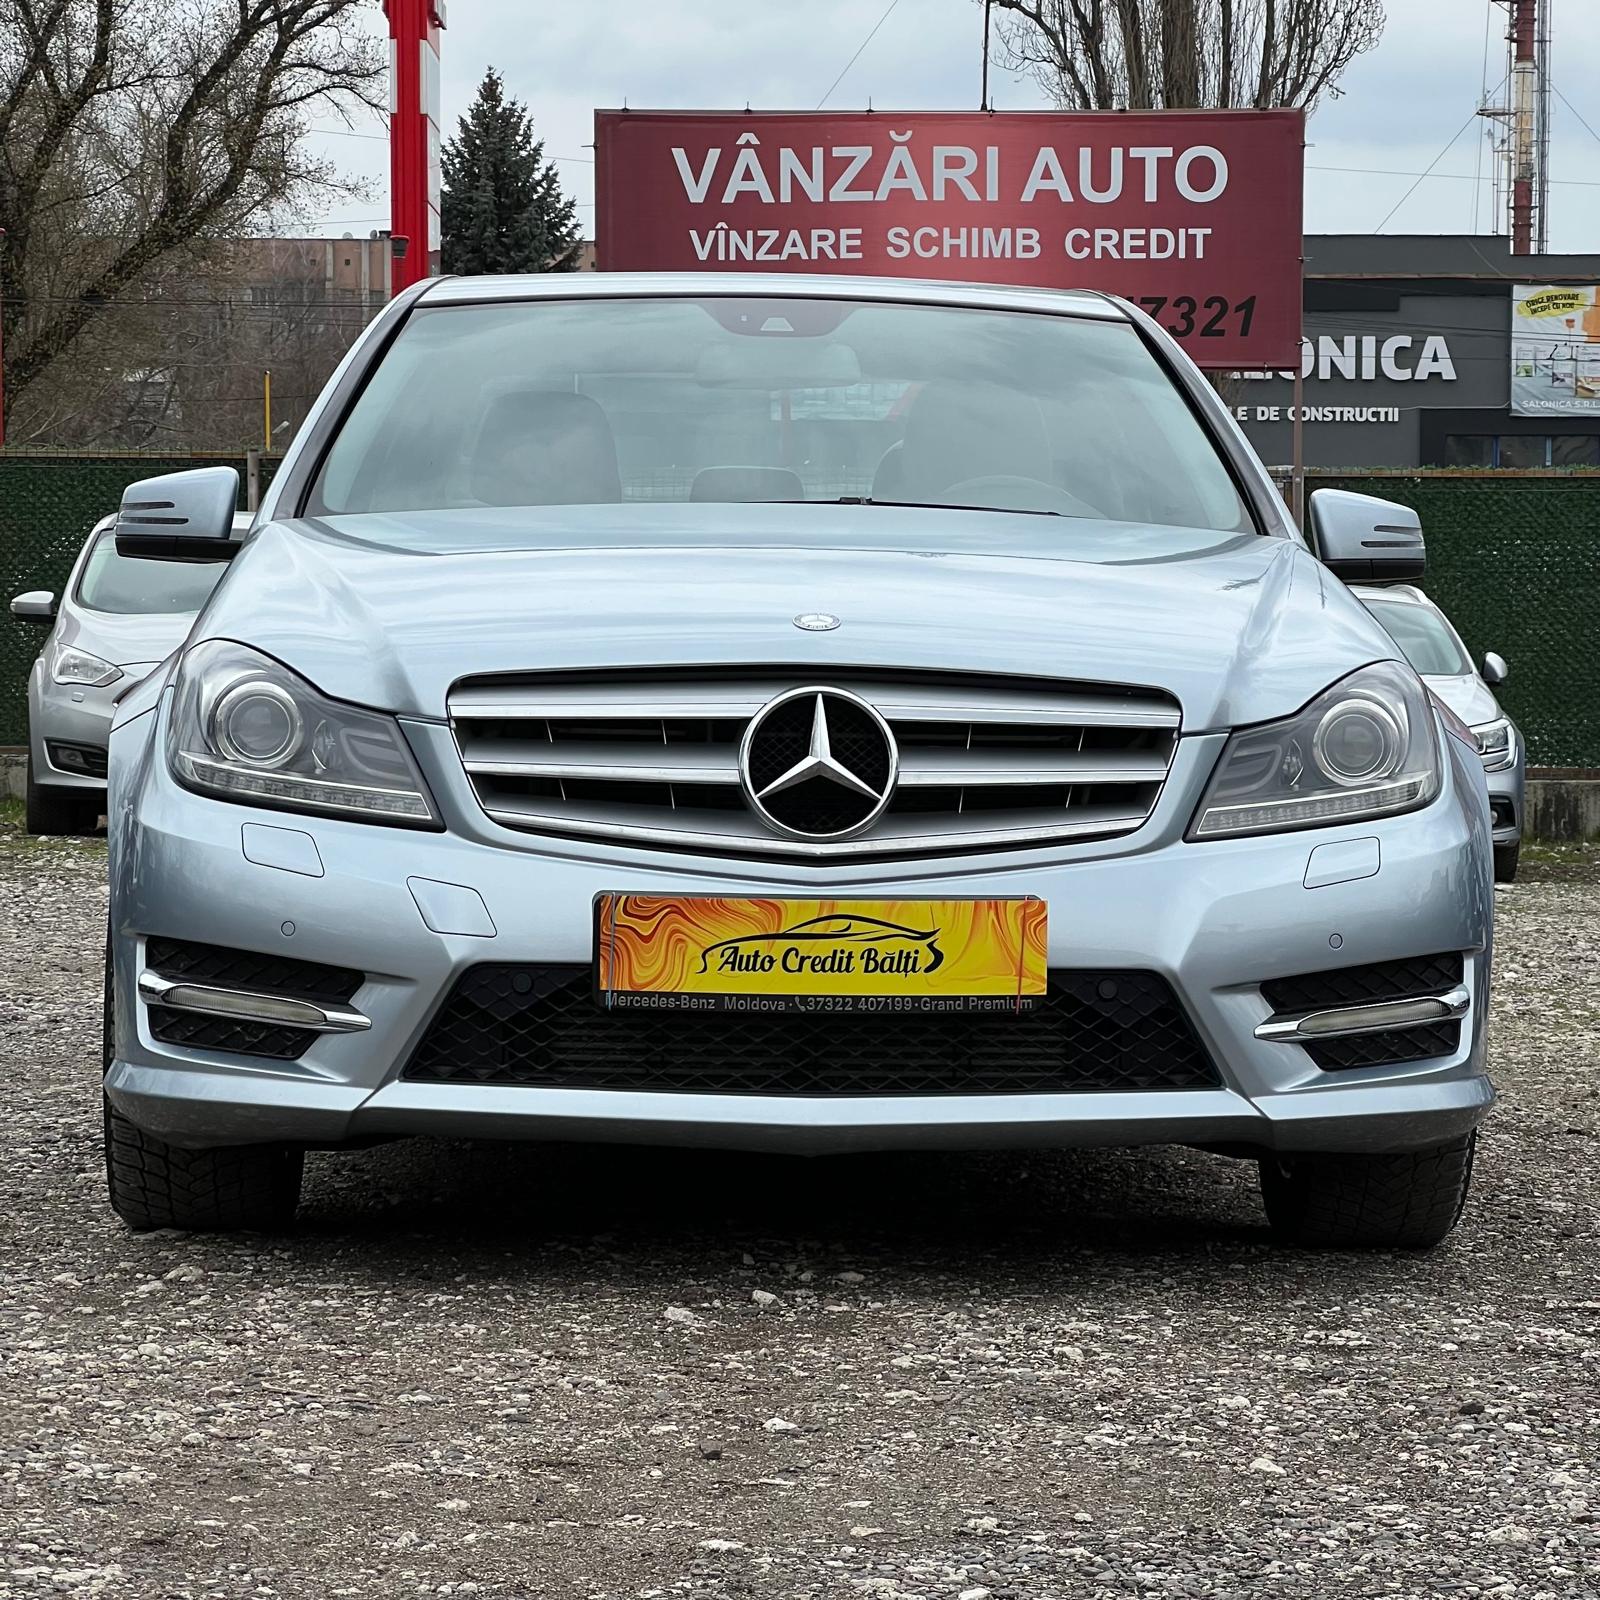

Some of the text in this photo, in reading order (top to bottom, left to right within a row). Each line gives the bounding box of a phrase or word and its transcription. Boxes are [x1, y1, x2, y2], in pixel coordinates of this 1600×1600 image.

[671, 129, 1230, 204] VÂNZĂRI AUTO
[689, 221, 1213, 262] VÎNZARE SCHIMB CREDIT
[1126, 295, 1257, 338] 7321
[1256, 406, 1280, 421] DE
[1287, 406, 1399, 423] CONSTRUCTII
[718, 946, 777, 973] Auto
[781, 946, 855, 973] Credit
[605, 992, 715, 1009] Mercedes-Benz
[724, 996, 786, 1011] Moldova
[806, 996, 853, 1011] 37322
[857, 997, 912, 1011] 407199
[920, 997, 964, 1011] Grand
